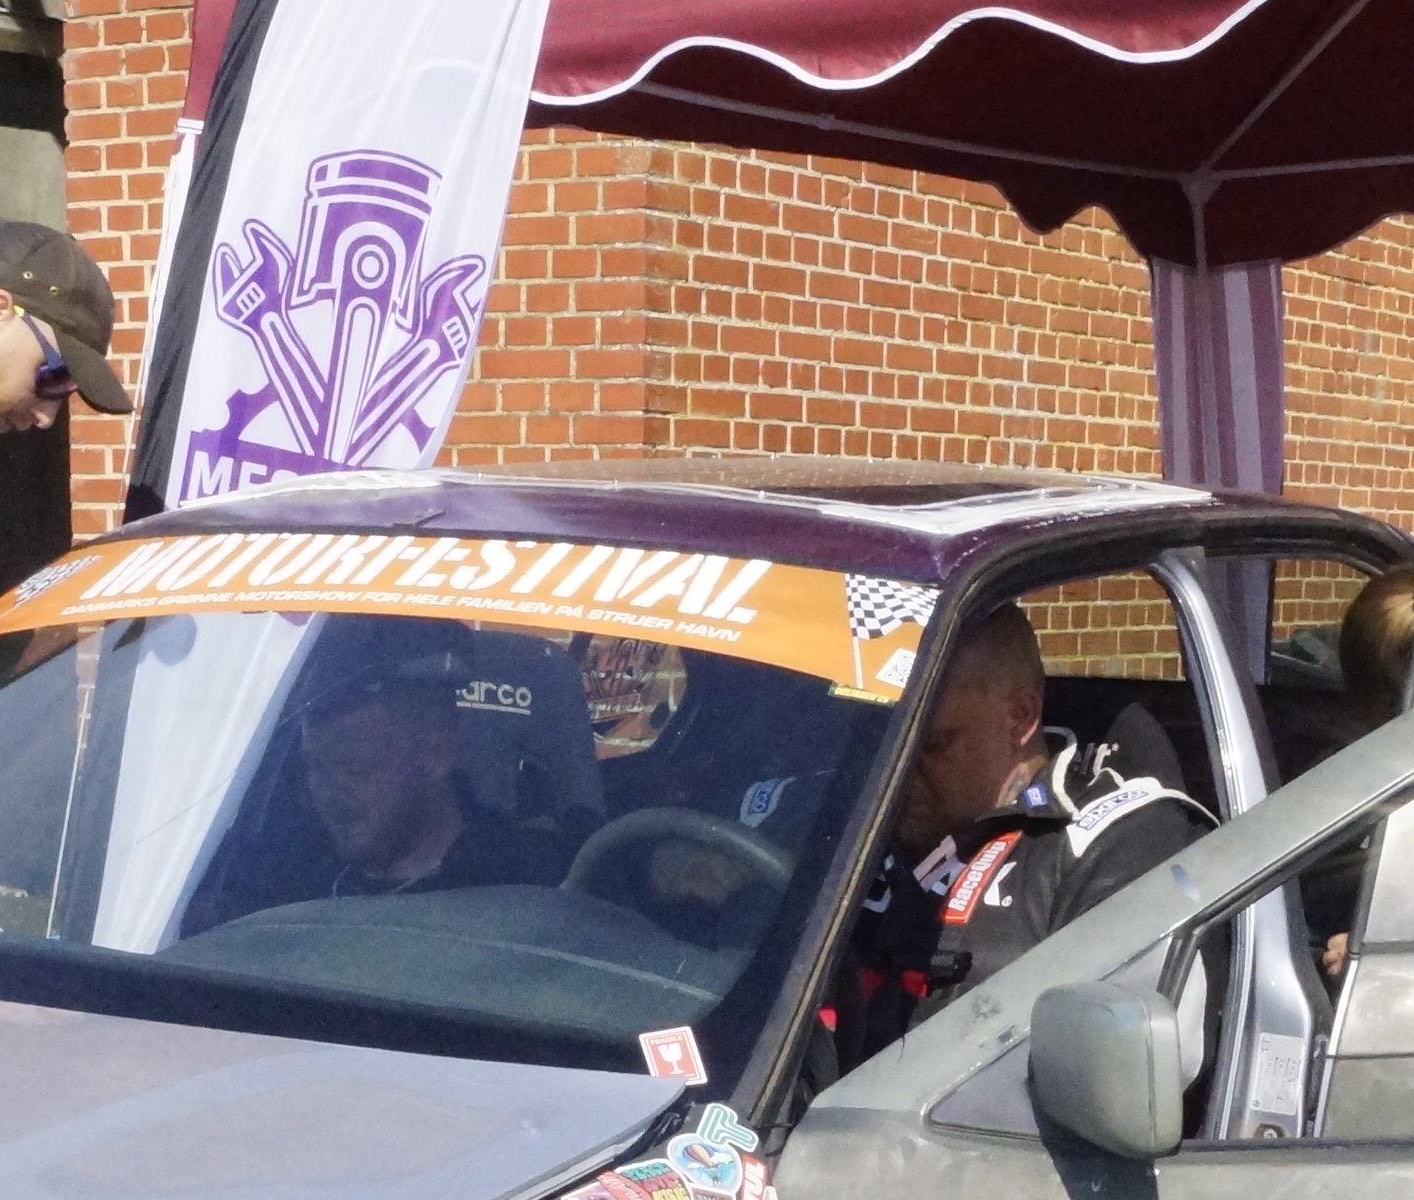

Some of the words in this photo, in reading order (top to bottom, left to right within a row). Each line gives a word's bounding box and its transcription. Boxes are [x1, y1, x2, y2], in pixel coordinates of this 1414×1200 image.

[79, 533, 772, 624] MOTORFESTIVAL
[60, 596, 160, 616] DANMARKS
[157, 591, 235, 606] GRØNNE
[234, 590, 362, 603] MOTORSHOW
[362, 591, 404, 603] FOR
[406, 592, 454, 607] HELE
[455, 593, 550, 616] FAMILIEN
[554, 603, 584, 618] PÅ
[586, 608, 675, 630] STRUER
[674, 621, 741, 642] HAVN
[455, 681, 532, 707] arco
[948, 841, 1008, 912] RaceQuip
